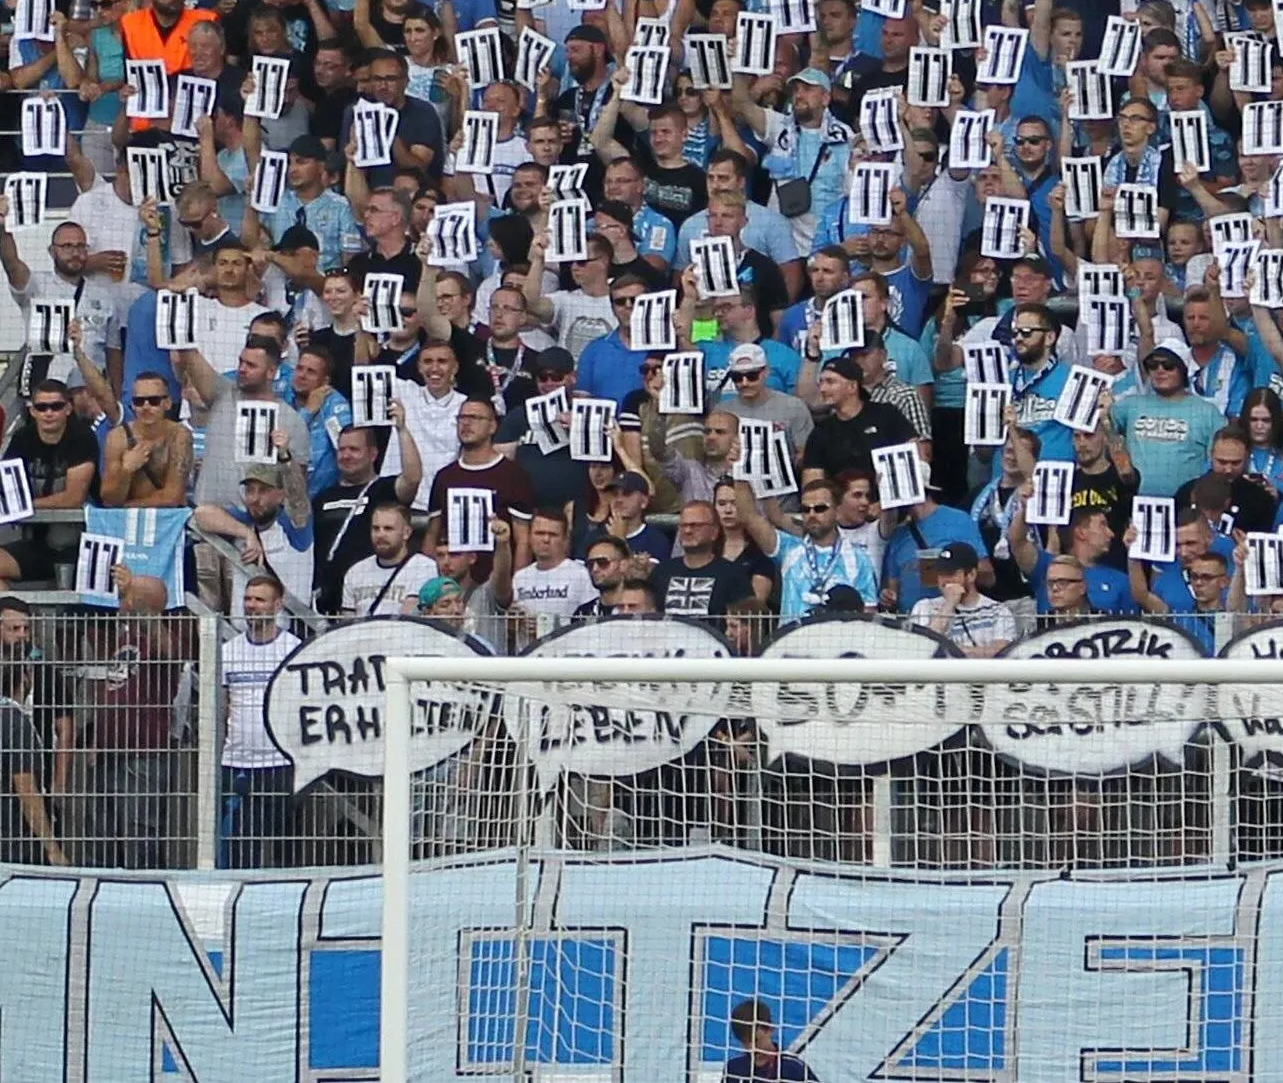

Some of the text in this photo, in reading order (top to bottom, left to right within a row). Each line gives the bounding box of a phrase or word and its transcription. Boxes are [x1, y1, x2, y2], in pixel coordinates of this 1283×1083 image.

[740, 18, 772, 70] 11
[989, 32, 1022, 78] 11
[631, 50, 664, 99] 11
[27, 102, 60, 149] 11
[467, 117, 494, 167] 11
[9, 178, 41, 226] 11
[552, 205, 582, 255] 11
[990, 204, 1028, 254] 11
[695, 243, 734, 292] 11
[1091, 300, 1124, 351] 11
[241, 408, 275, 457] 11
[1138, 504, 1170, 555] 11
[300, 704, 486, 746] ERHLTEN
